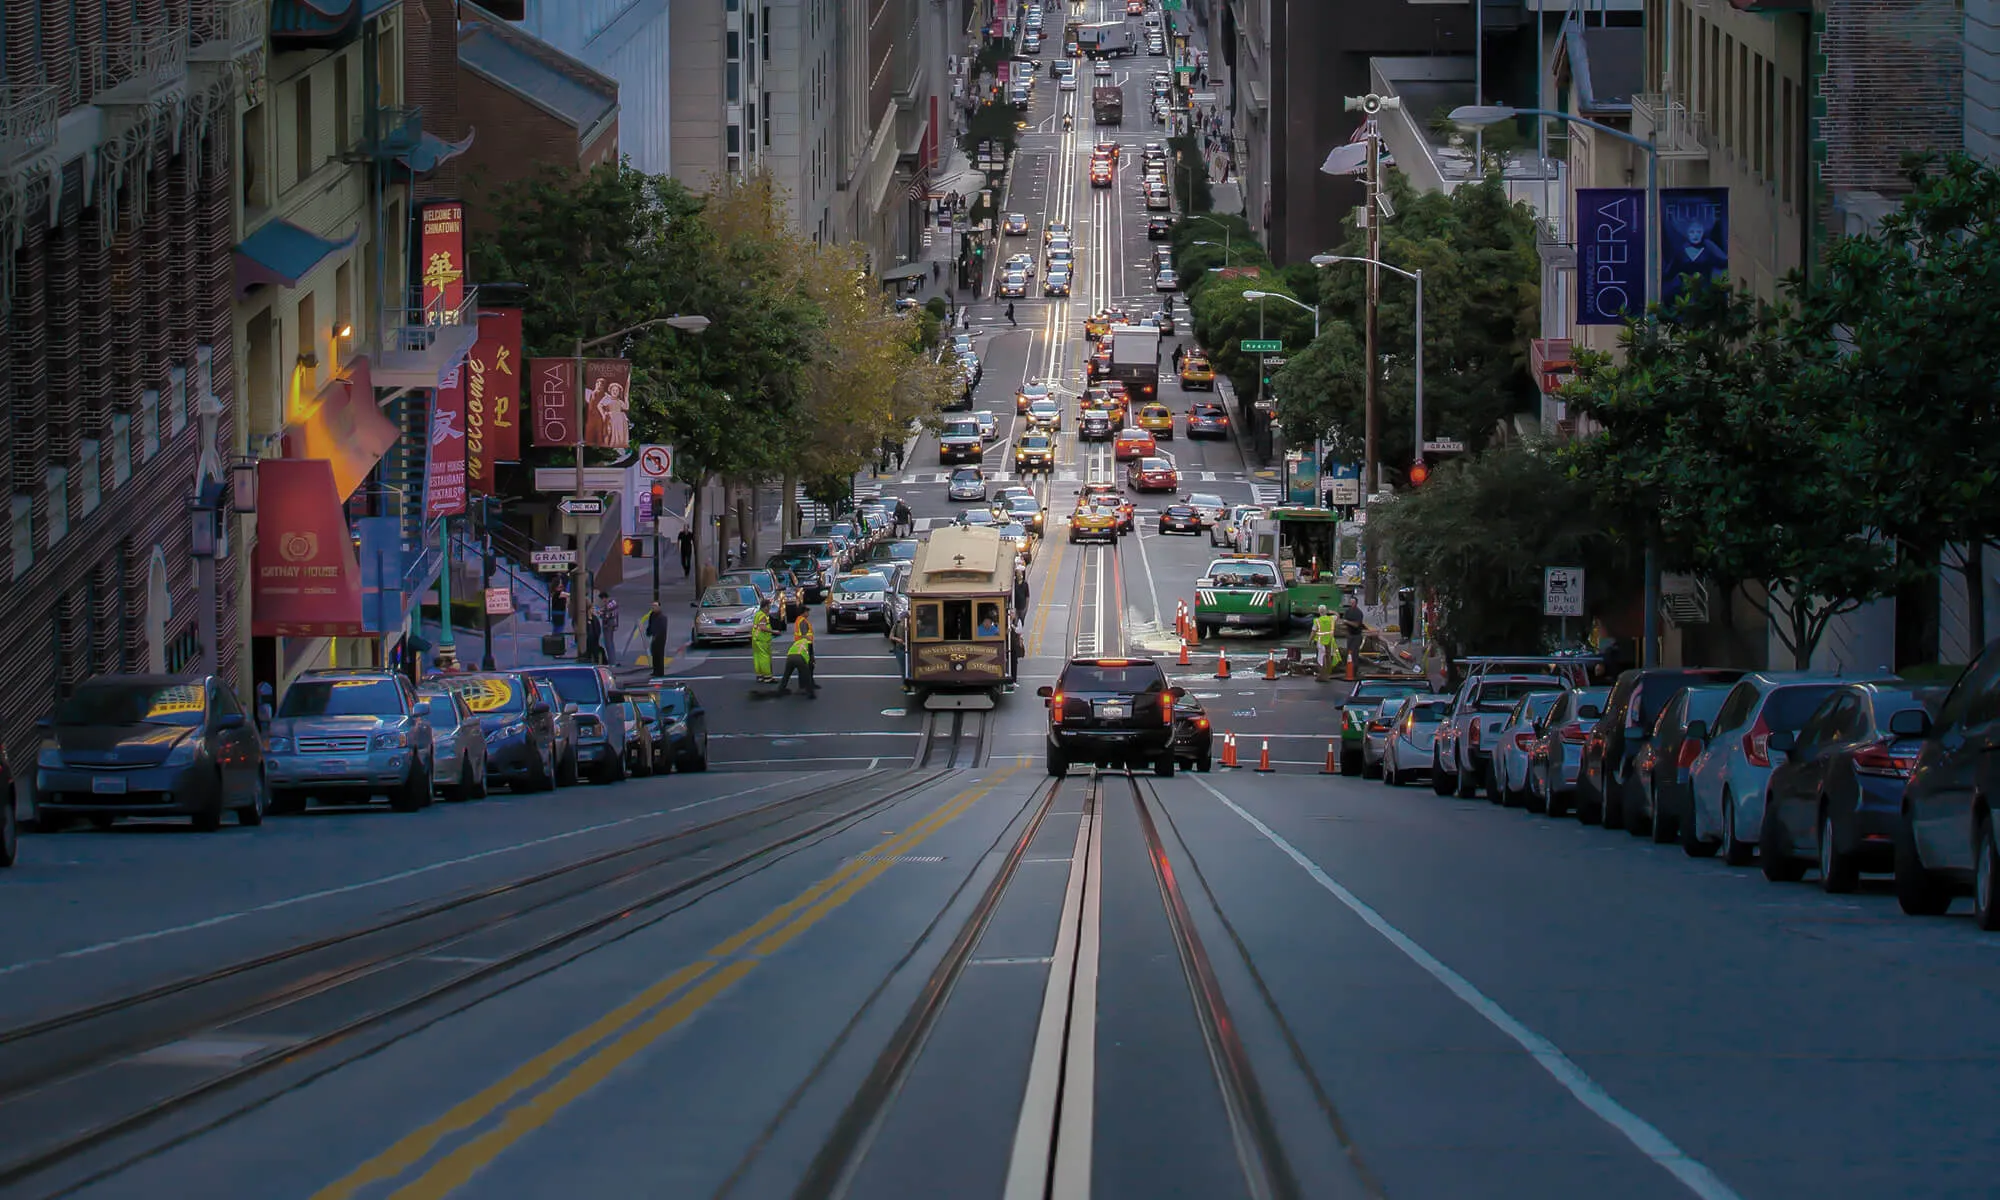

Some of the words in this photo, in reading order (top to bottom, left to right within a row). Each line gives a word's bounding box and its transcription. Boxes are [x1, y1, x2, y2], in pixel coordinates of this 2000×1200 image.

[423, 209, 452, 221] WELCOME
[453, 208, 462, 219] TO
[425, 221, 460, 234] CHINATOWN
[1596, 197, 1628, 318] OPERA
[544, 363, 567, 441] OPERA
[429, 473, 464, 488] ESTAURANT
[535, 553, 573, 561] GRANT
[261, 566, 299, 577] CATHAY
[304, 566, 338, 577] HOUSE
